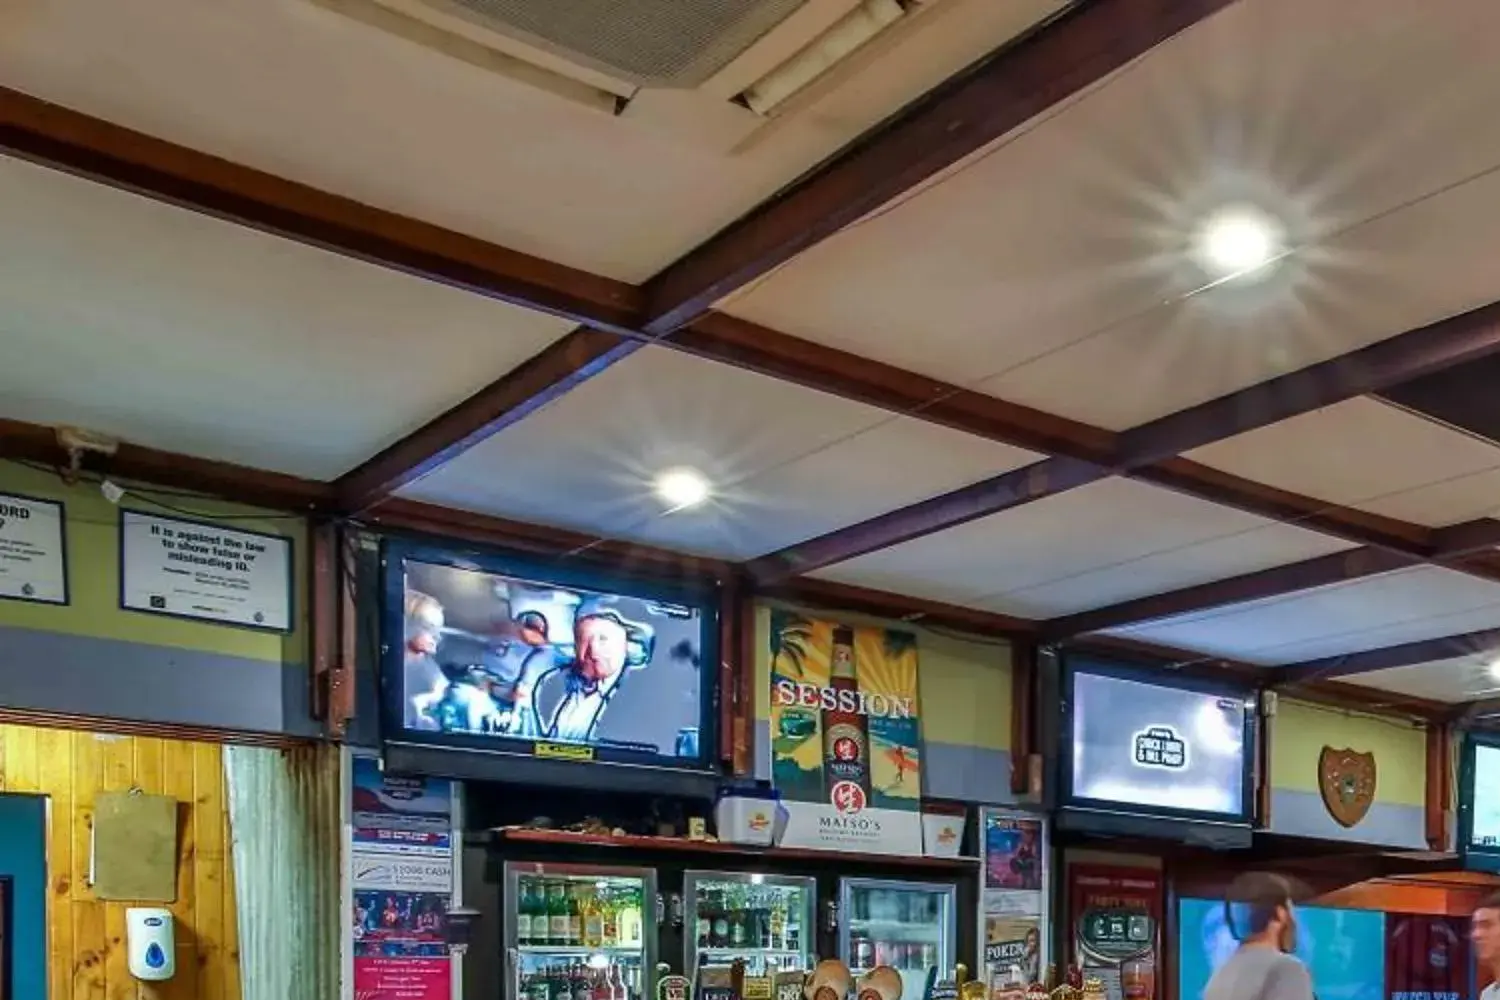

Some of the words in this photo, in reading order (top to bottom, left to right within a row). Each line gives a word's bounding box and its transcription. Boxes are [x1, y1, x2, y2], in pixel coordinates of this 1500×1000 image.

[151, 525, 160, 535] It
[163, 528, 174, 537] is
[177, 532, 220, 545] against
[223, 538, 242, 549] the
[245, 541, 266, 553] law
[162, 538, 175, 549] to
[177, 541, 209, 554] show
[212, 547, 241, 559] false
[243, 553, 256, 562] or
[167, 552, 233, 571] misleading
[235, 561, 250, 573] ID.
[777, 680, 914, 719] SESSION
[819, 816, 881, 831] MATSO'S
